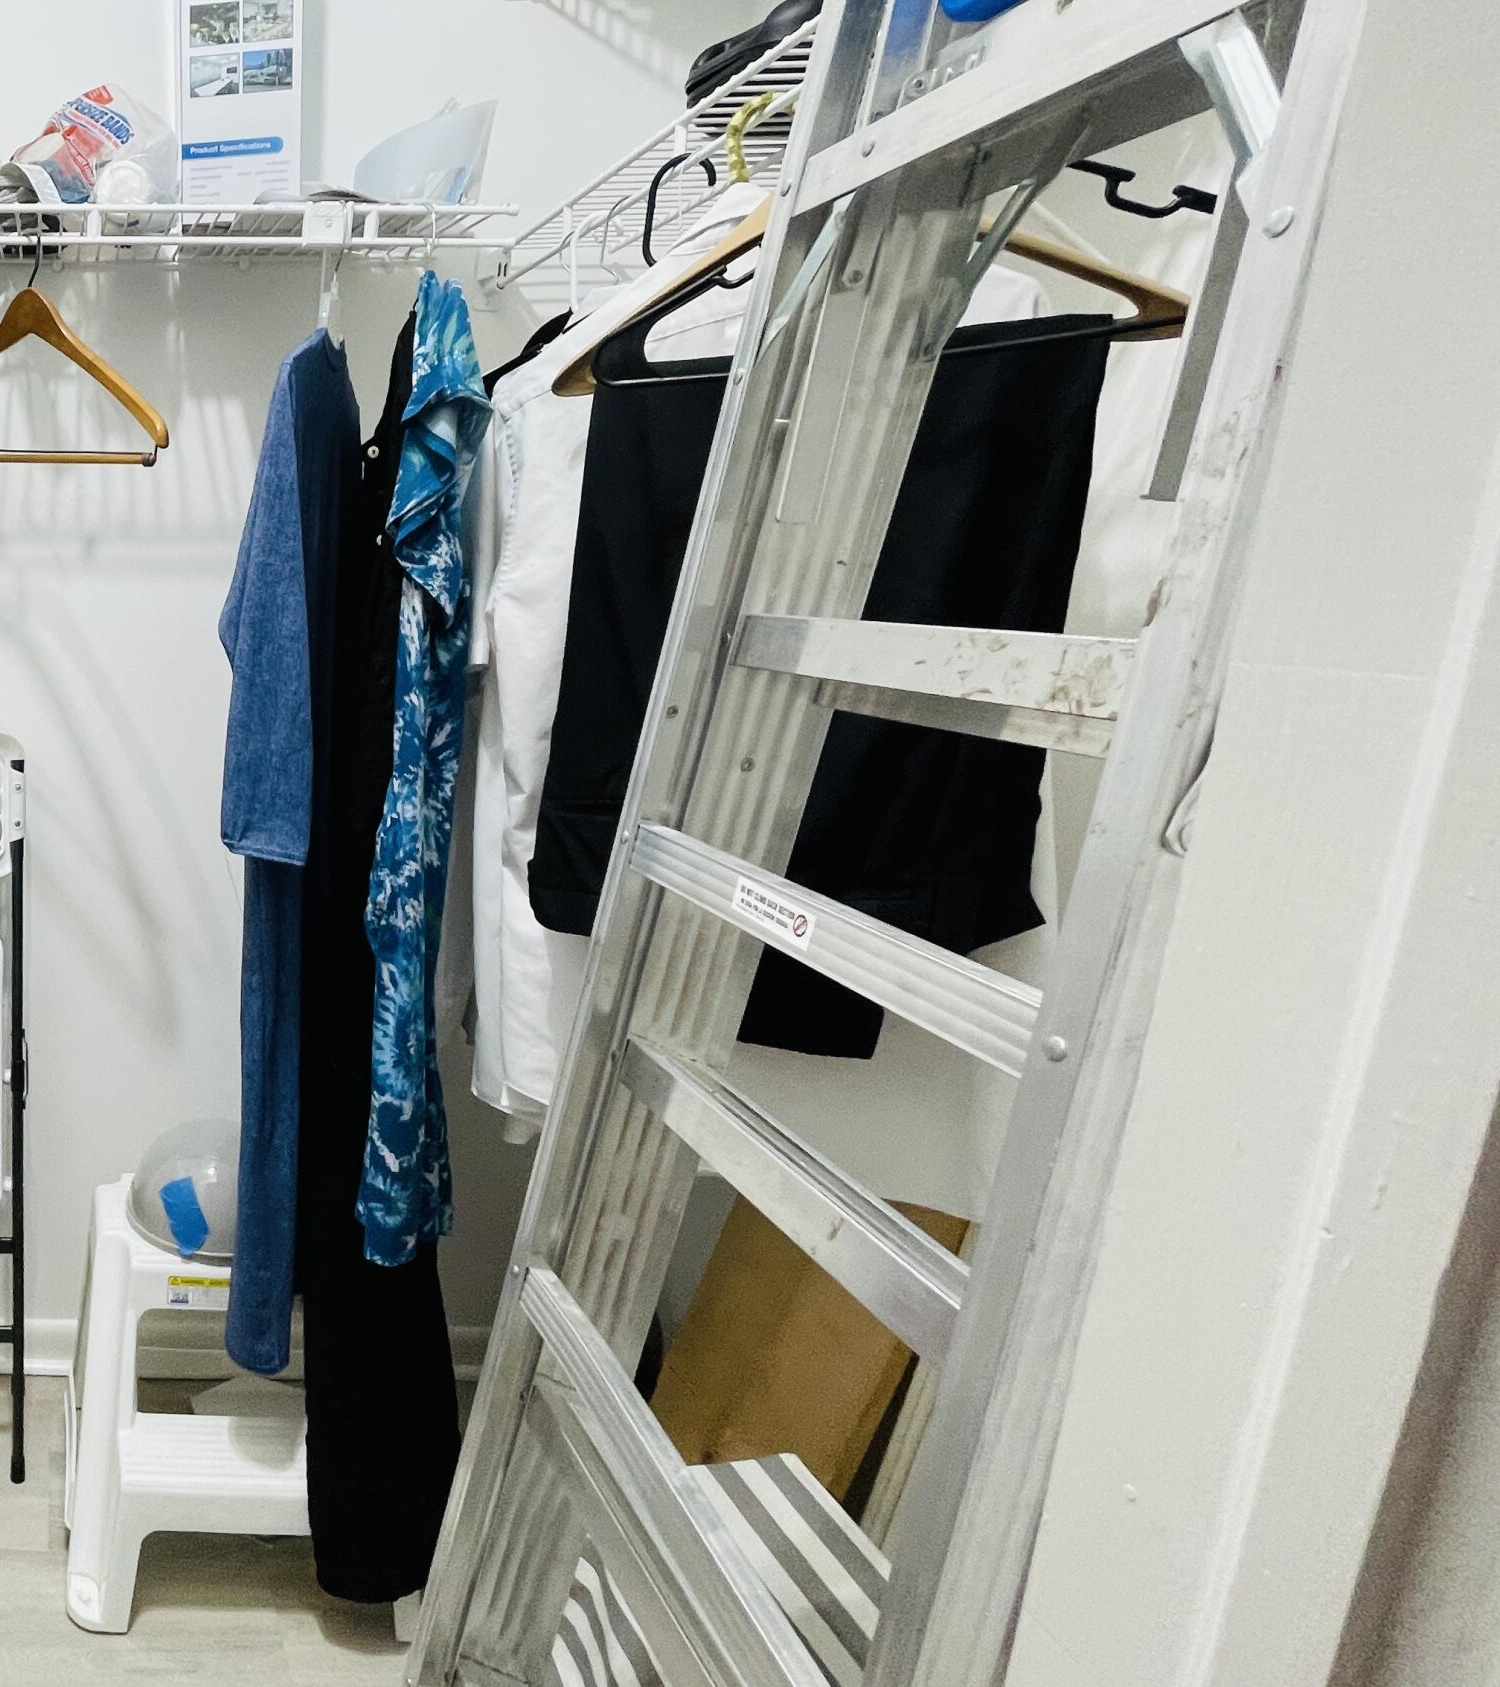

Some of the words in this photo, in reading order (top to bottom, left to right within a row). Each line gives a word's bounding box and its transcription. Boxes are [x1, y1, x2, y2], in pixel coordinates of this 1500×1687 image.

[100, 115, 135, 145] BANDS
[190, 146, 218, 155] Product
[219, 142, 271, 153] Specifications
